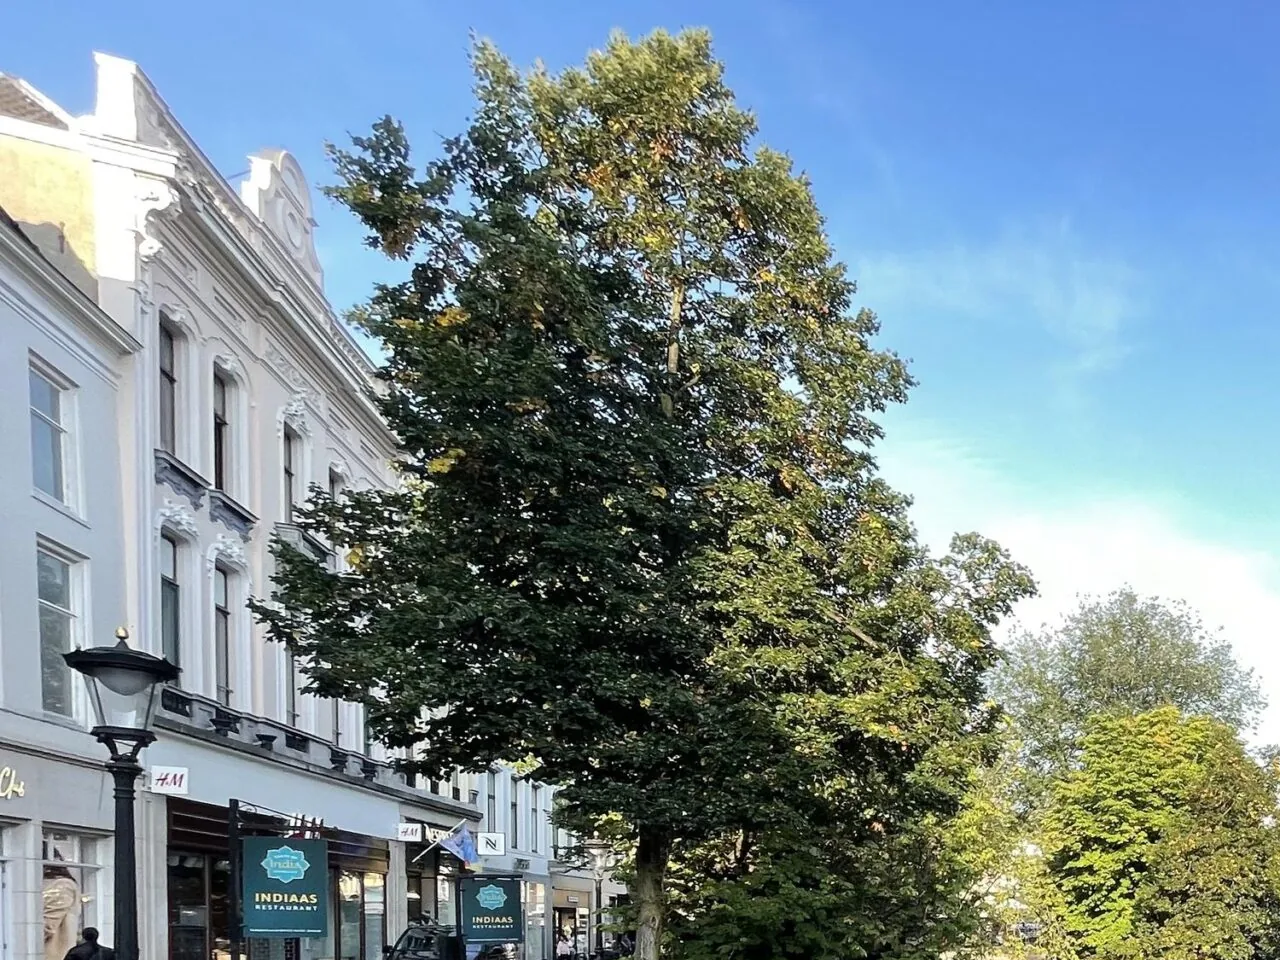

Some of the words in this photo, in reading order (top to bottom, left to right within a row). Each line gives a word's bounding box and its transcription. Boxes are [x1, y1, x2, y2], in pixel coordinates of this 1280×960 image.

[155, 772, 184, 788] H&M
[255, 893, 318, 904] INDIAAS
[472, 916, 514, 924] INDIAAS
